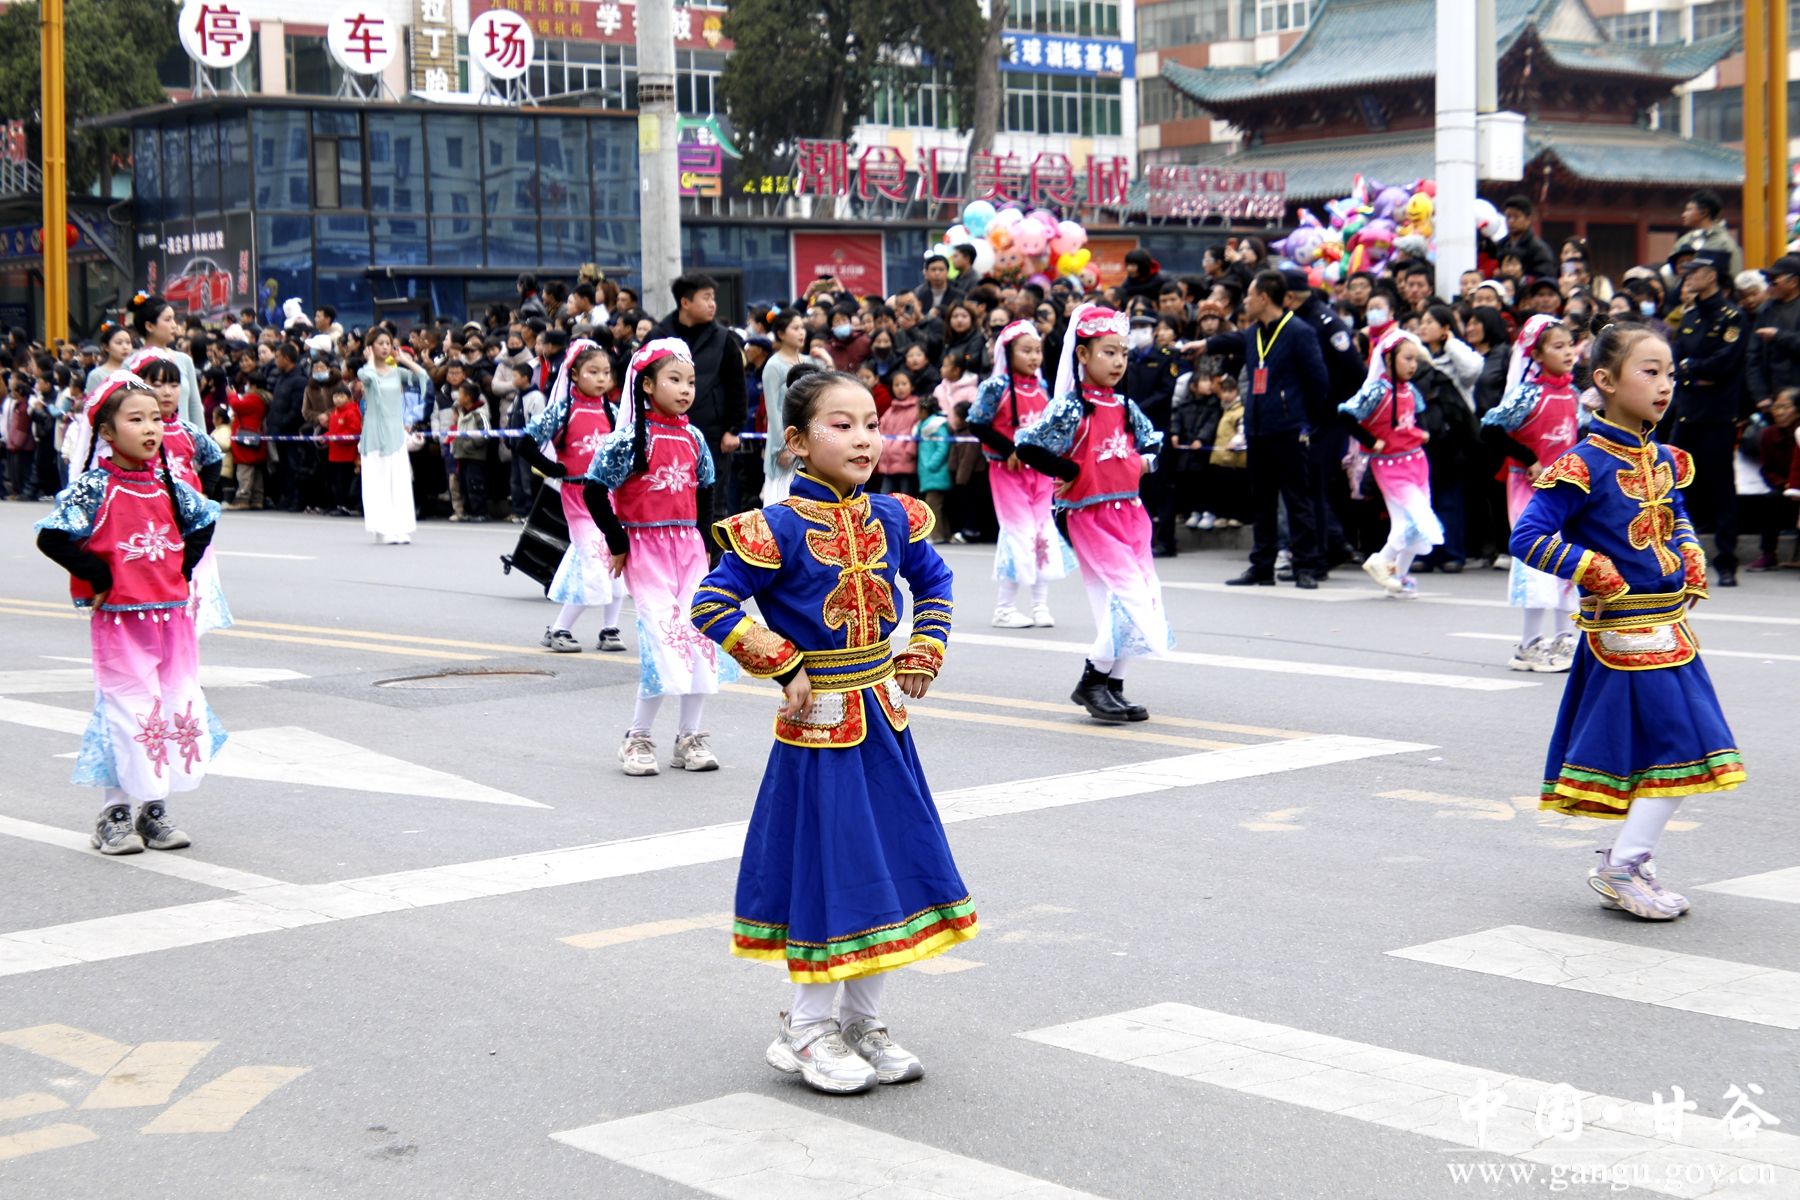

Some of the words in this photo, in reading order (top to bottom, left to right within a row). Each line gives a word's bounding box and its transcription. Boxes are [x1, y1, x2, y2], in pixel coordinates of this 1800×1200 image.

[195, 4, 525, 68] 停车场
[796, 140, 1129, 206] 潮食汇美食城
